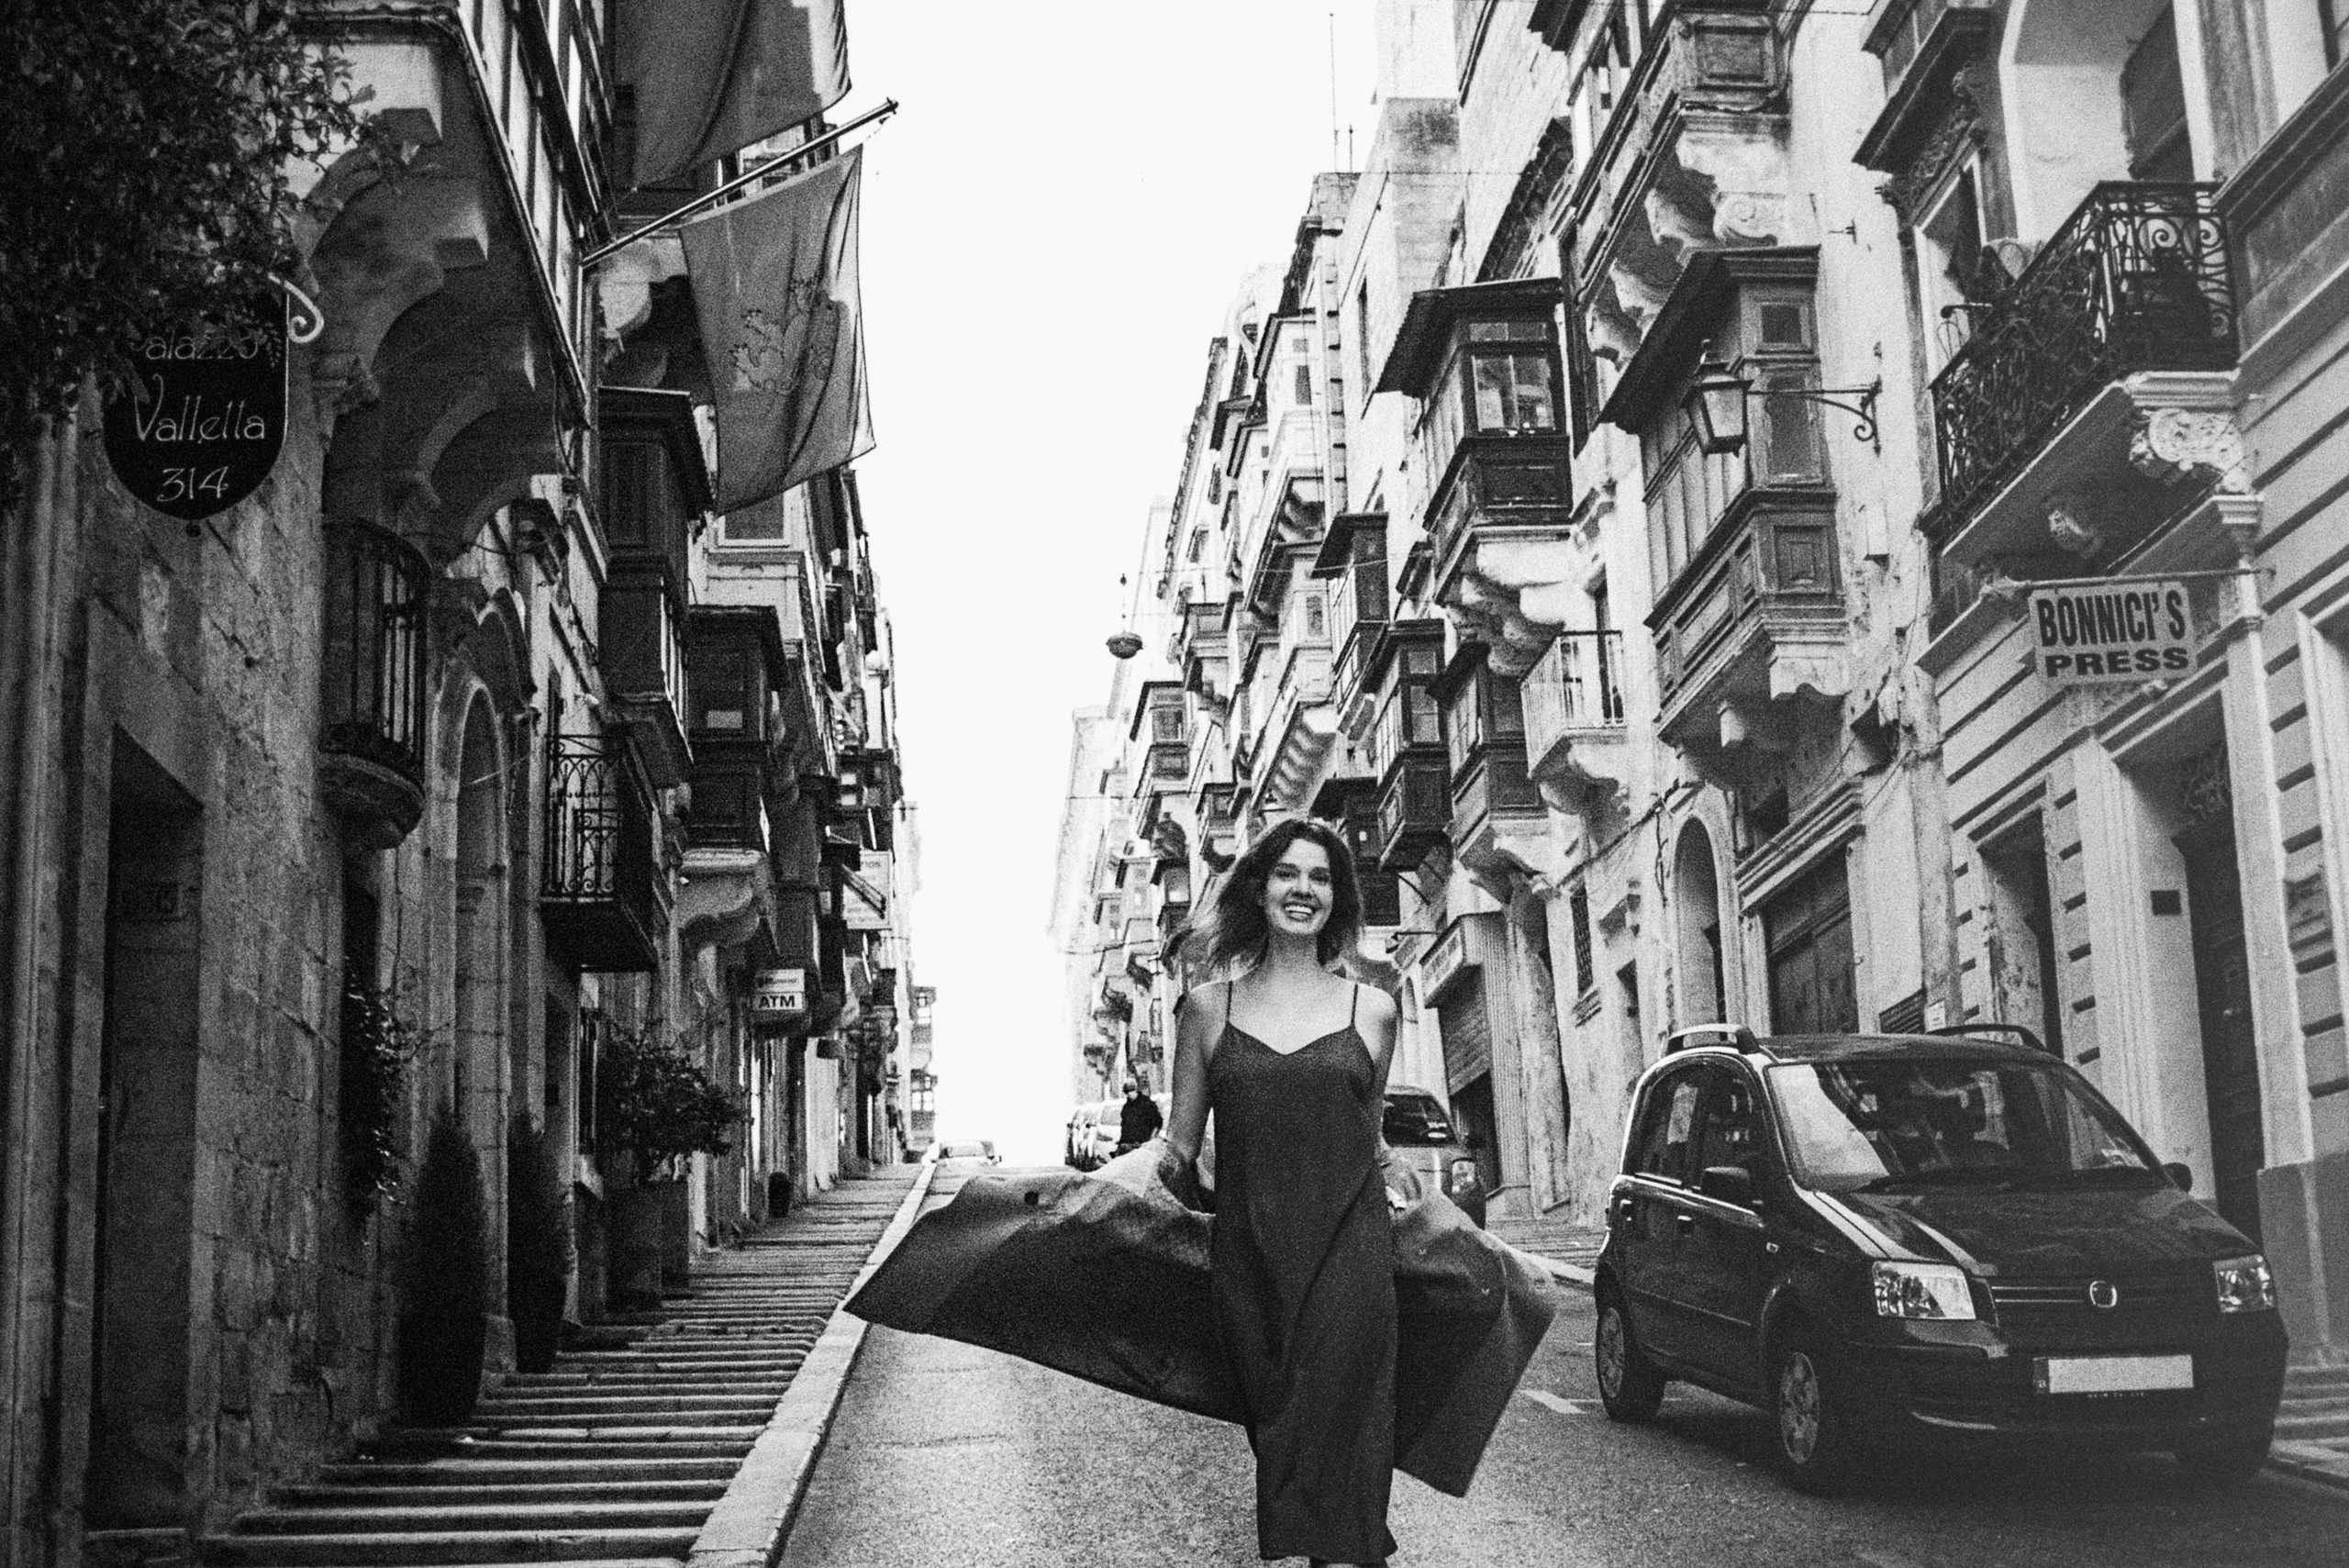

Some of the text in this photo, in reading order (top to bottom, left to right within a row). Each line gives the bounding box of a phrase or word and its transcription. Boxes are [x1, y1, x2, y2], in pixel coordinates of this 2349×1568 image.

[129, 327, 259, 360] alazzo
[135, 373, 265, 444] Valletta
[157, 465, 229, 503] 314
[2035, 589, 2186, 647] BONNICI'S
[2044, 646, 2189, 678] PRESS
[758, 995, 795, 1008] ATM
